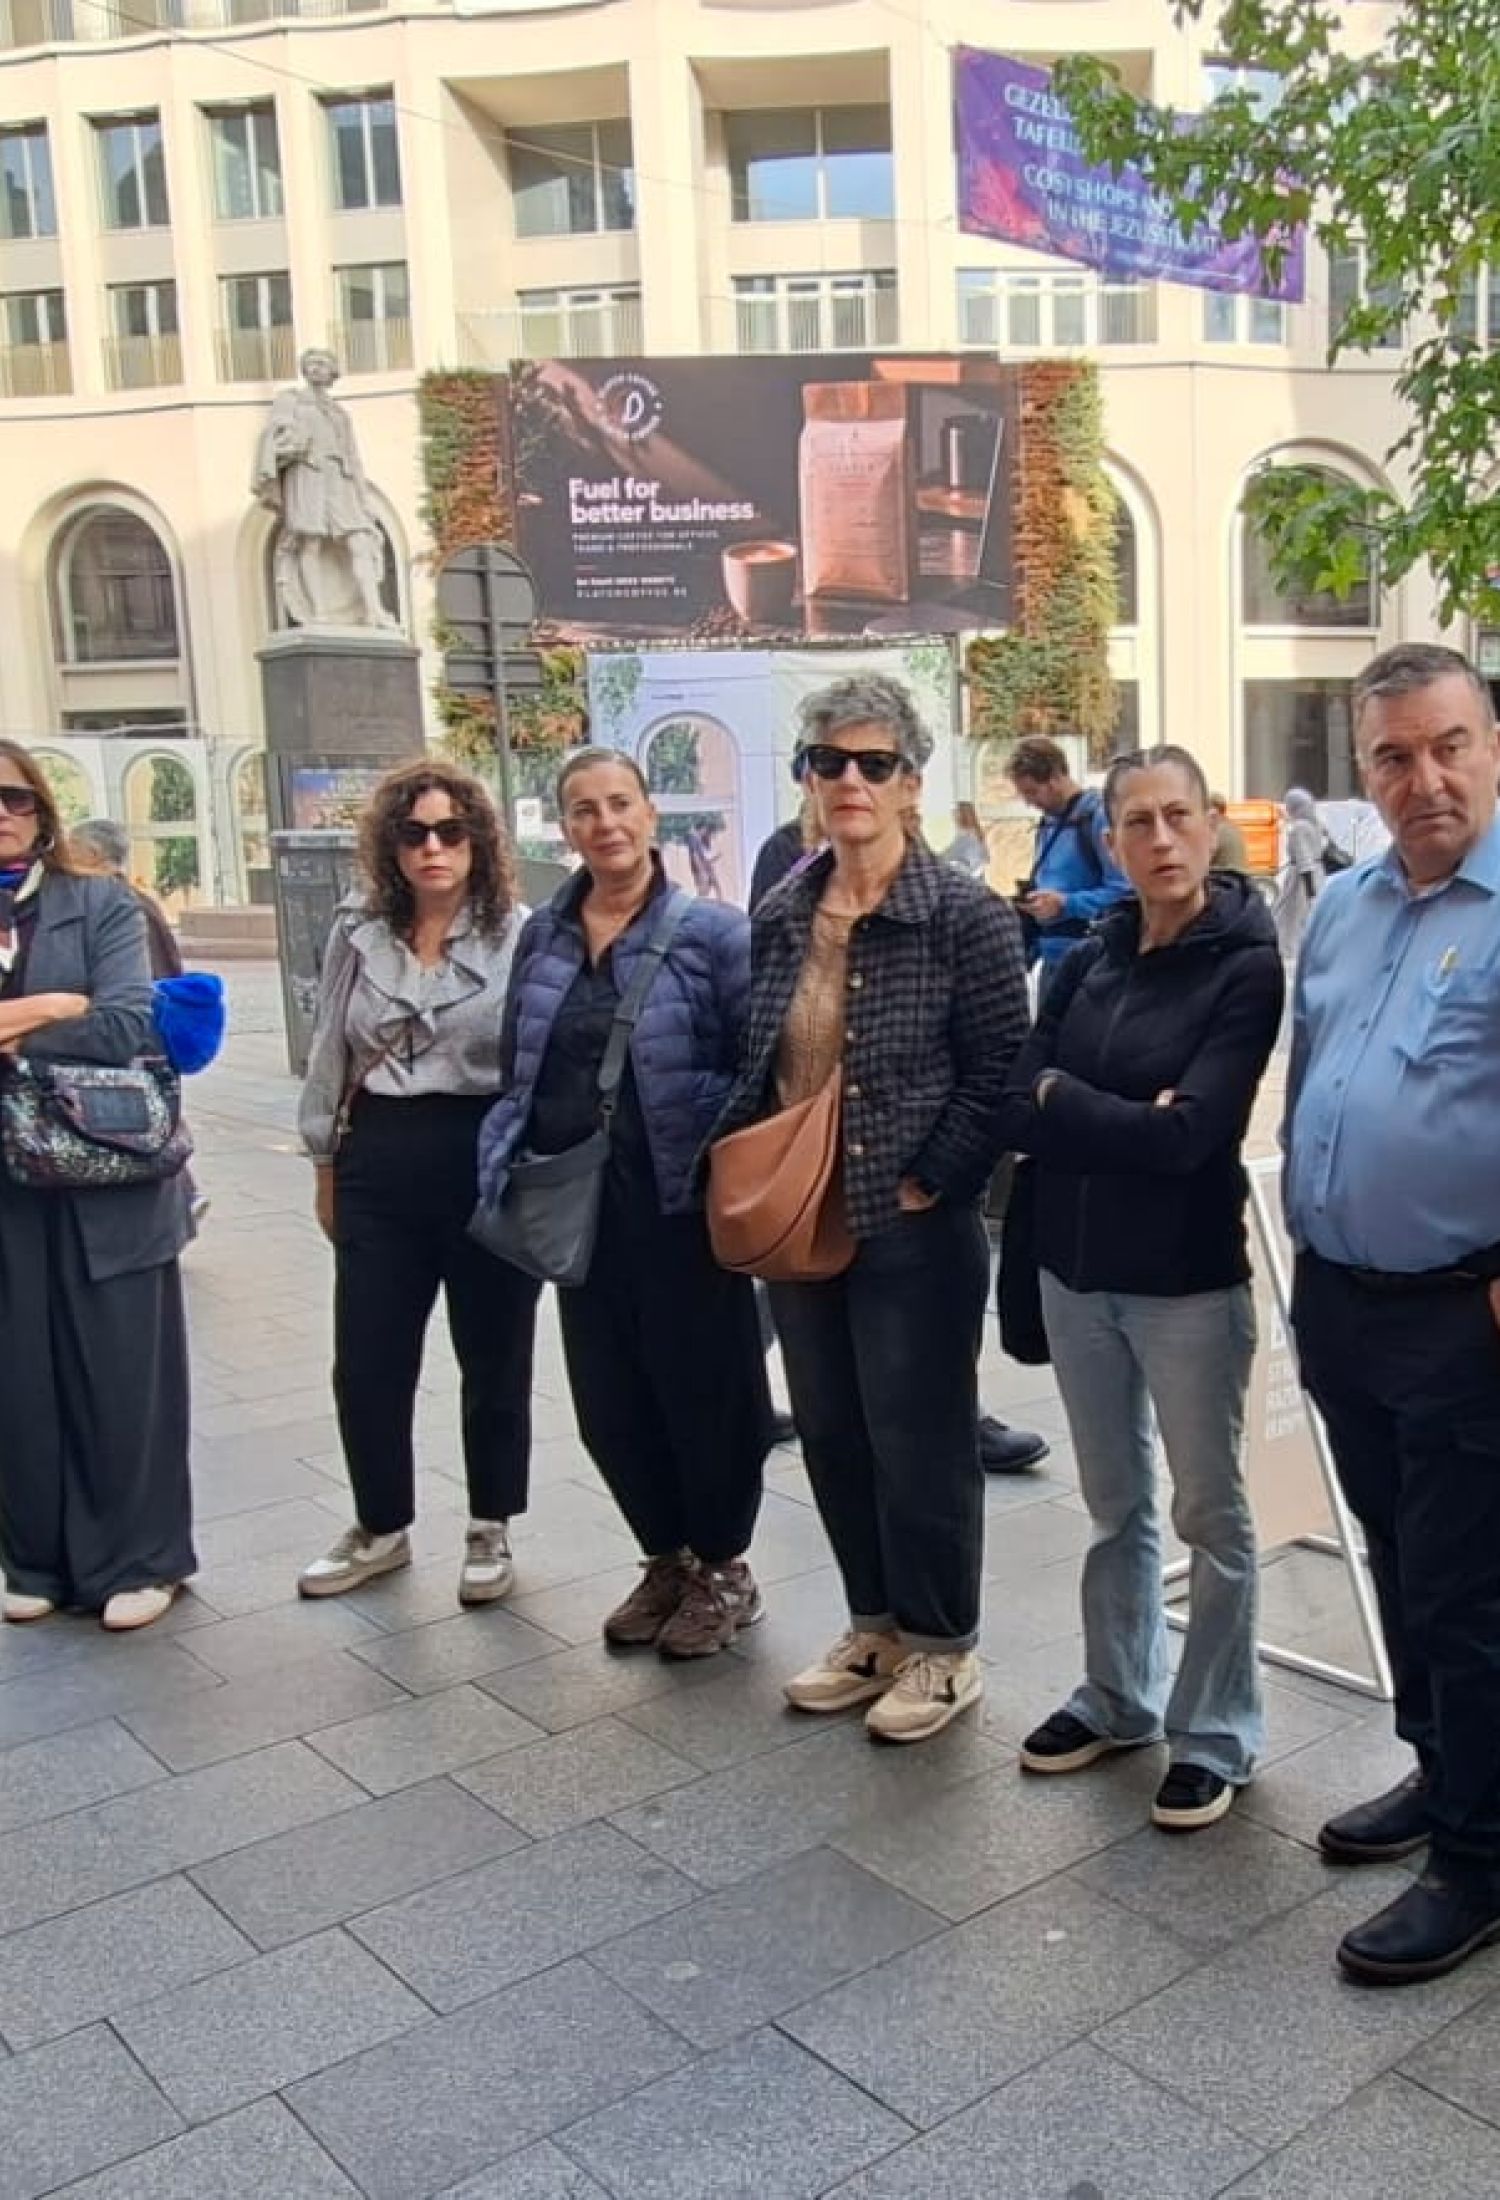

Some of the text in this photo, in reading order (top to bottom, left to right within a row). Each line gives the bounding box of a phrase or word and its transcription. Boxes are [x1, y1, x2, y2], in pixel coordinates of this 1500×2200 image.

[569, 477, 660, 498] Fuel for
[571, 500, 646, 523] better
